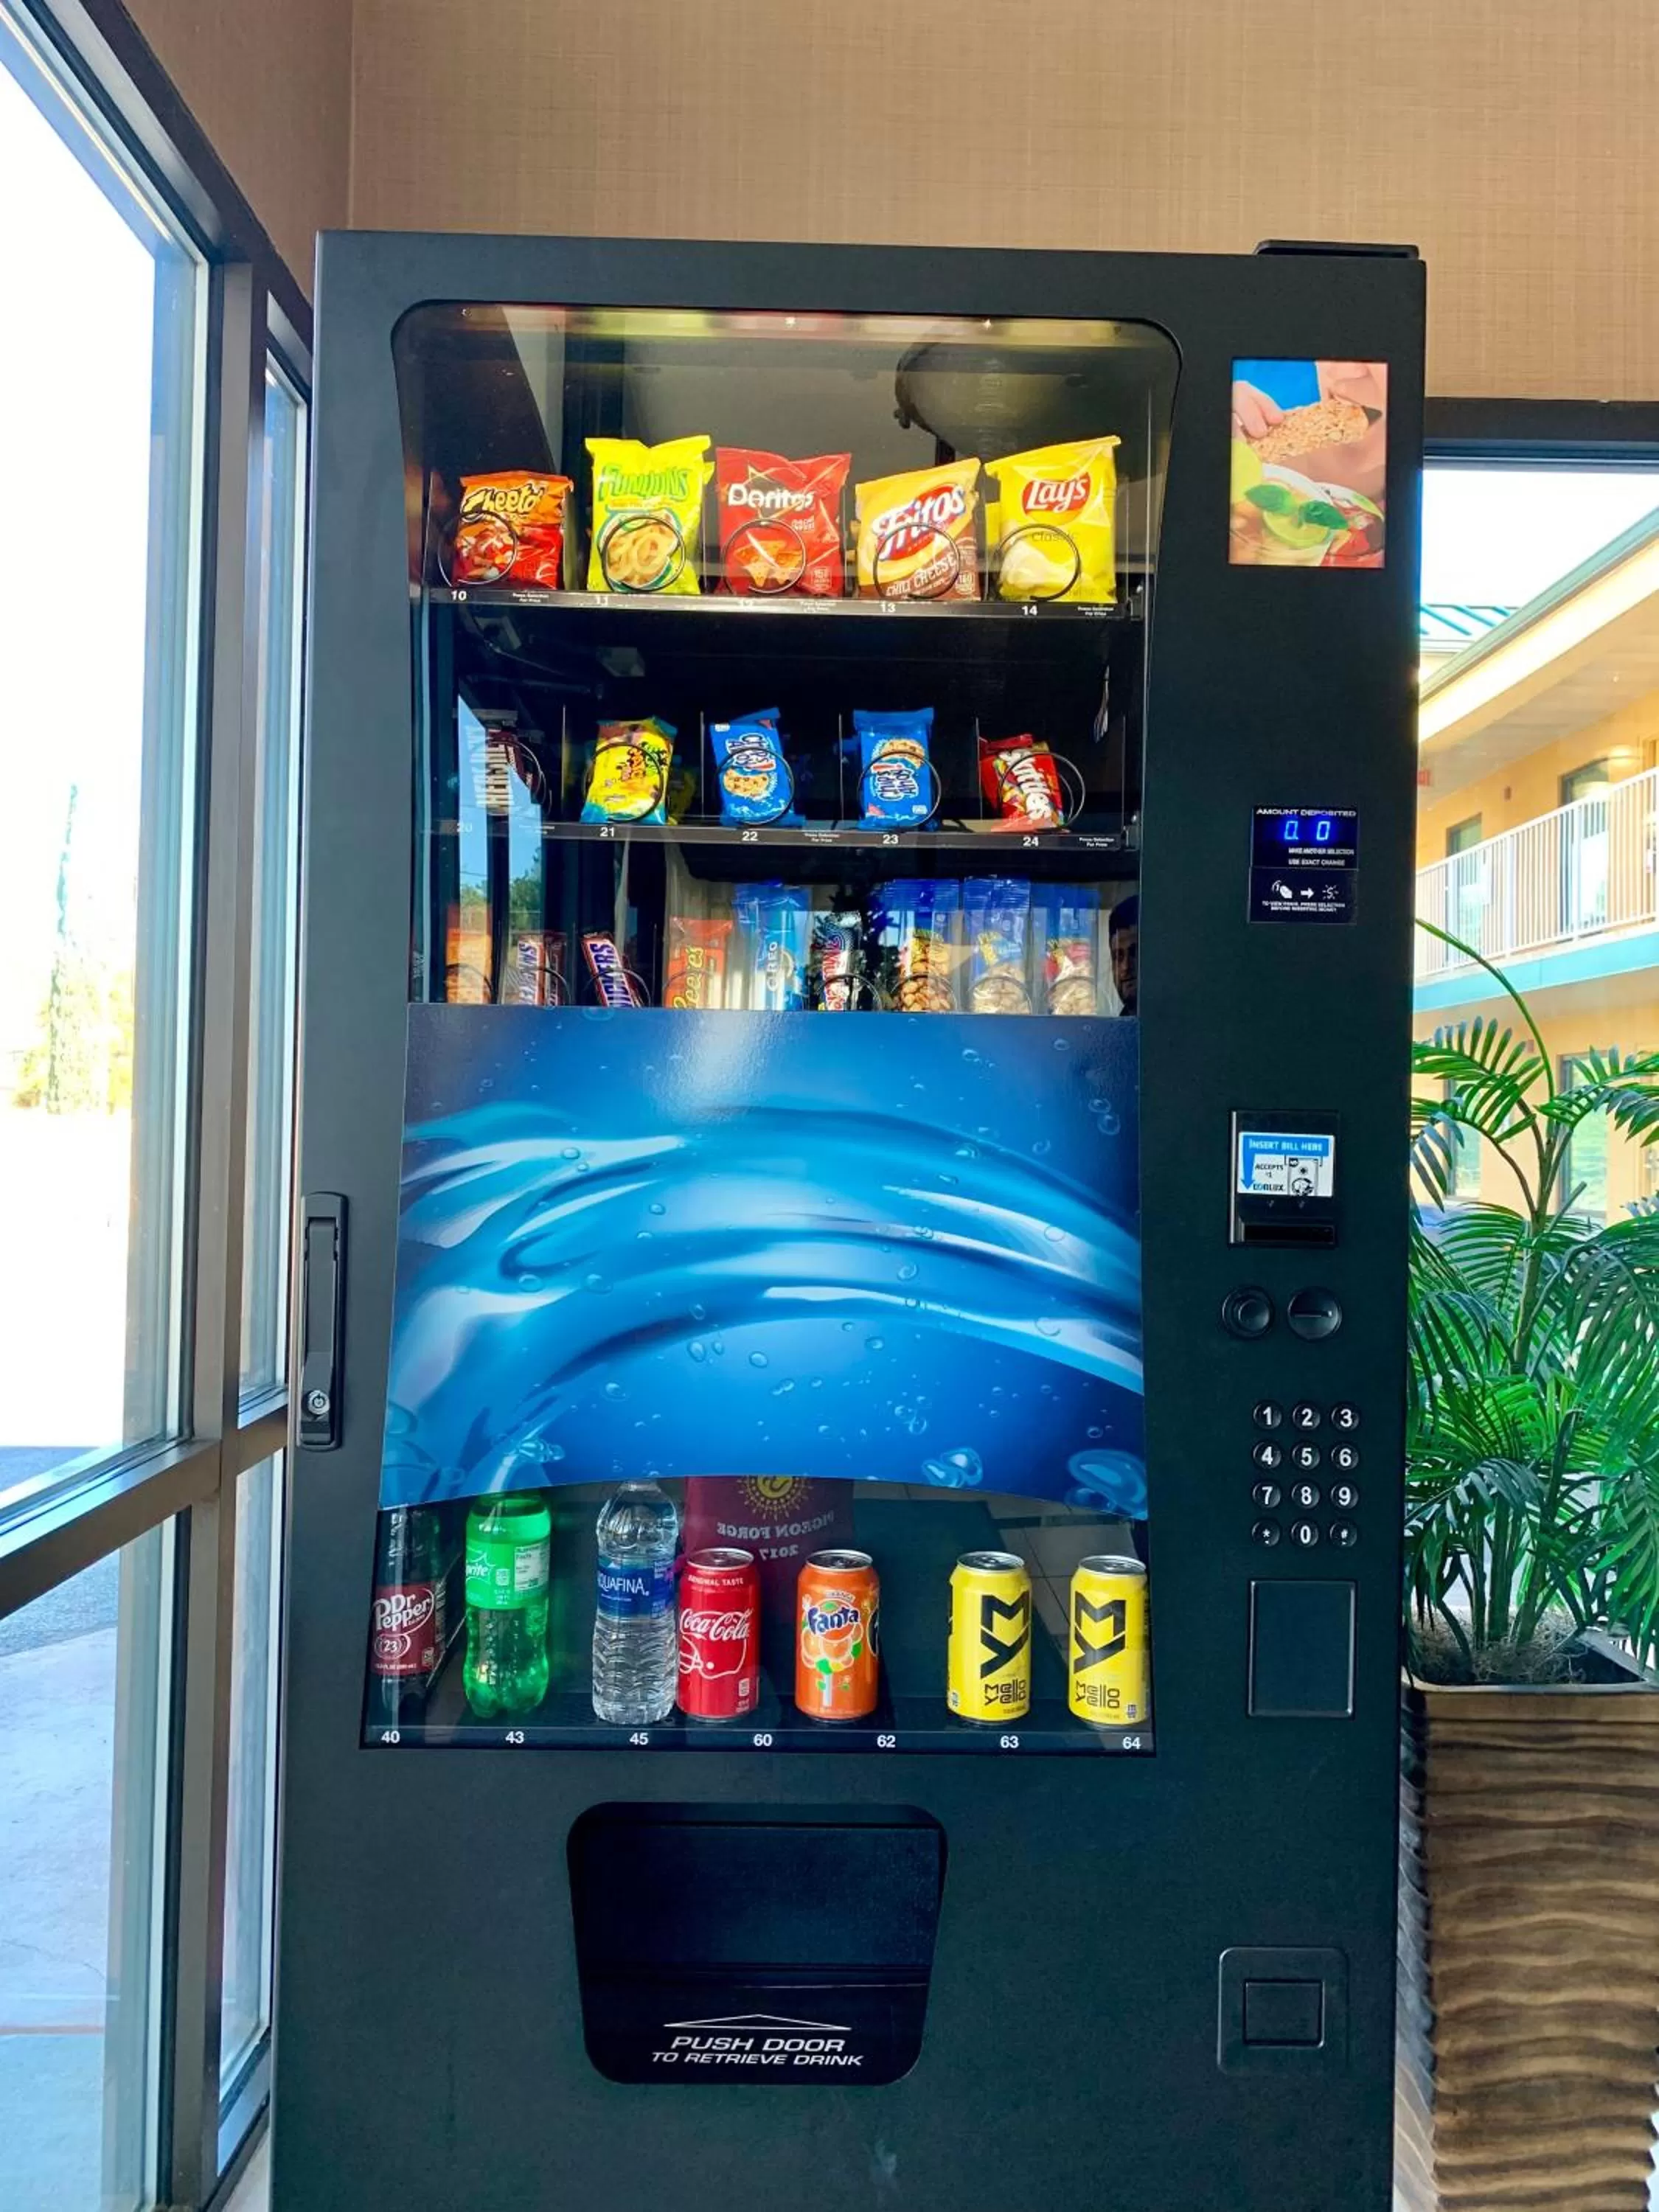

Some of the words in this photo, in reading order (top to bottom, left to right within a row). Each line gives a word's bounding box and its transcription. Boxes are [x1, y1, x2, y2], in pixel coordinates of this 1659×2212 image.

[462, 482, 544, 513] Cheeto
[728, 483, 815, 510] Doritos
[872, 484, 965, 561] Fritos
[914, 553, 956, 587] CHEESE
[451, 591, 467, 601] 10
[880, 603, 896, 613] 13
[1022, 605, 1037, 616] 14
[1301, 809, 1356, 817] DEPOSITED
[600, 827, 615, 837] 21
[742, 832, 758, 841] 22
[883, 835, 899, 844] 23
[1023, 837, 1039, 846] 24
[766, 942, 779, 992] OREO
[1249, 1138, 1279, 1150] INSERT
[1281, 1141, 1298, 1151] BILL
[1301, 1142, 1322, 1152] HERE
[1263, 1406, 1272, 1425] 1
[1301, 1408, 1313, 1426] 2
[1340, 1408, 1352, 1427] 3
[1262, 1446, 1273, 1465] 4
[1301, 1447, 1312, 1466] 5
[1340, 1448, 1352, 1467] 6
[1262, 1486, 1273, 1505] 7
[1301, 1486, 1312, 1505] 8
[1338, 1486, 1350, 1506] 9
[1300, 1525, 1311, 1544] 0
[688, 1574, 719, 1586] ORIGINAL
[722, 1578, 744, 1586] TASTE
[390, 1593, 417, 1614] Dr
[372, 1597, 431, 1631] Pepper
[383, 1640, 397, 1652] 23
[381, 1731, 400, 1743] 40
[505, 1731, 524, 1744] 43
[630, 1733, 649, 1745] 45
[754, 1733, 773, 1746] 60
[877, 1735, 897, 1747] 62
[1001, 1736, 1019, 1748] 63
[1122, 1737, 1141, 1749] 64
[670, 2037, 754, 2051] PUSH
[762, 2038, 845, 2052] DOOR
[652, 2052, 679, 2063] TO
[684, 2053, 788, 2065] RETRIEVE
[793, 2054, 864, 2066] DRINK
